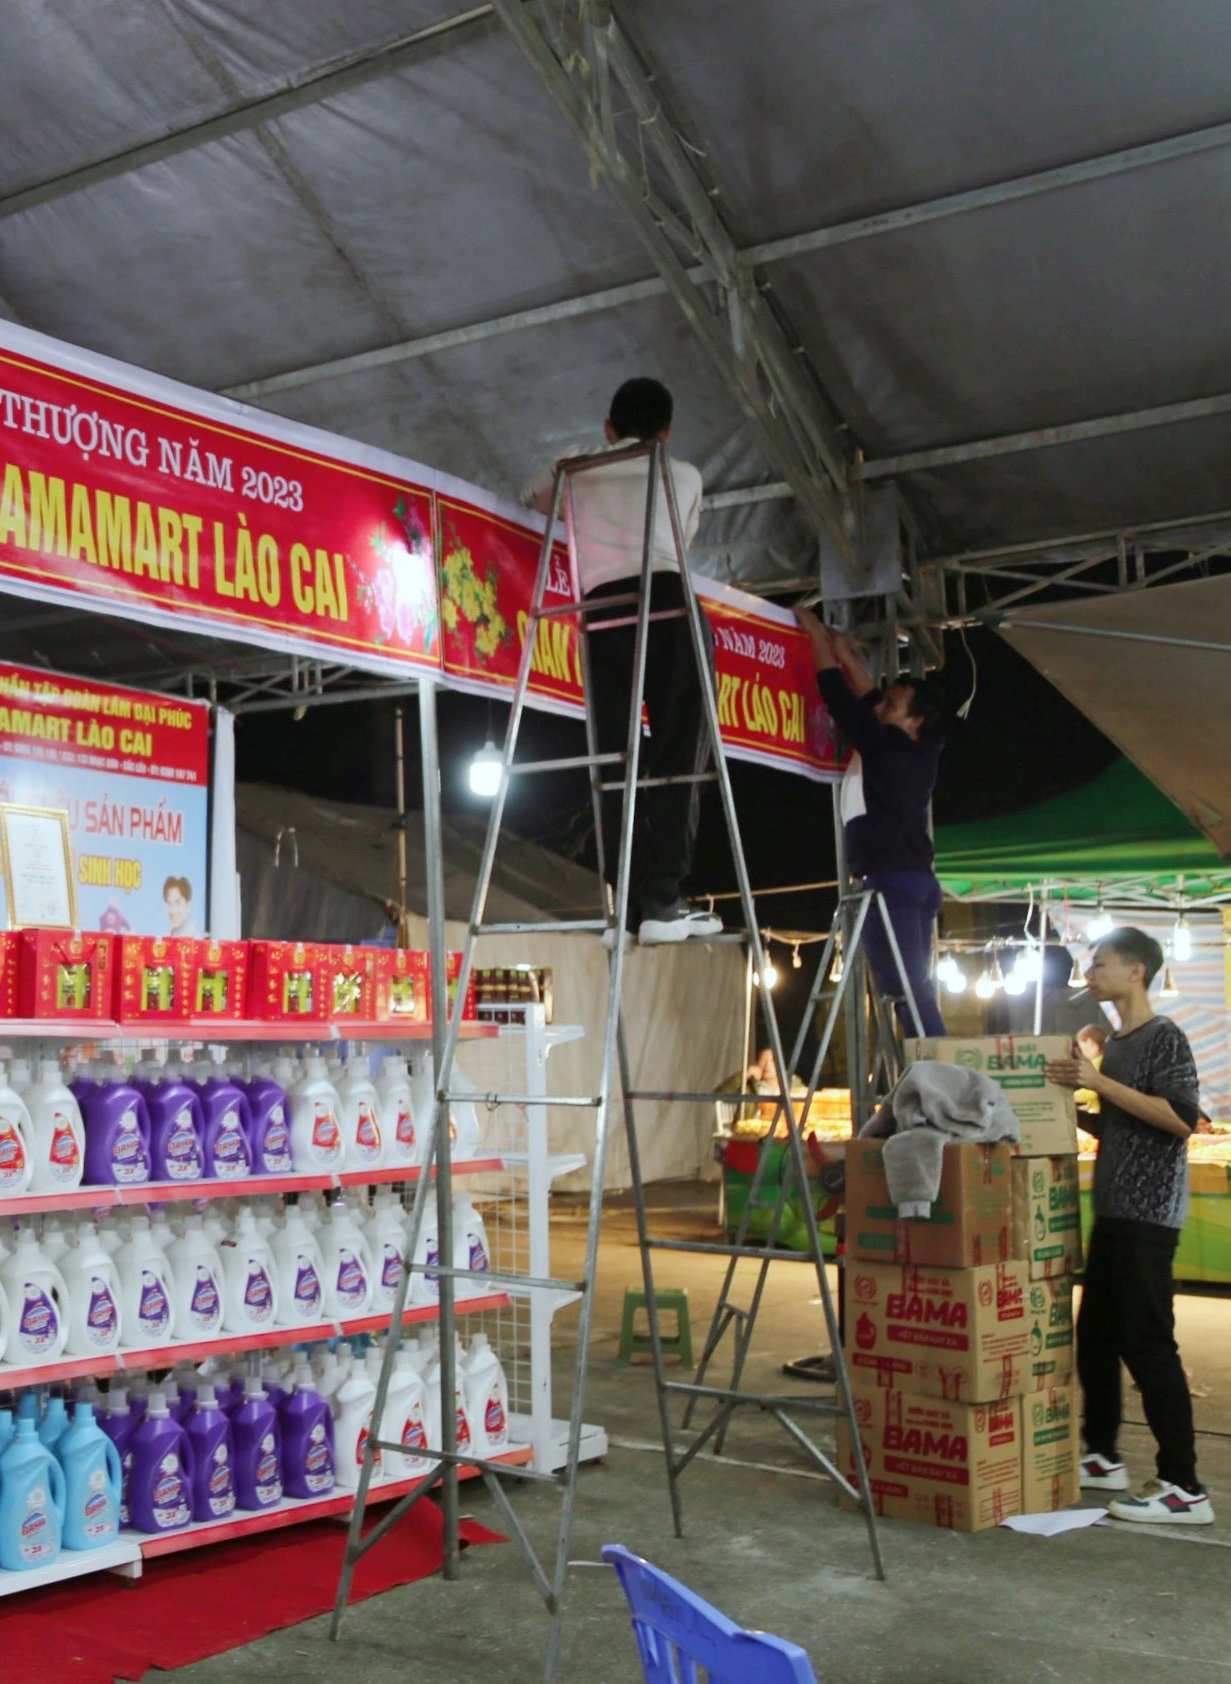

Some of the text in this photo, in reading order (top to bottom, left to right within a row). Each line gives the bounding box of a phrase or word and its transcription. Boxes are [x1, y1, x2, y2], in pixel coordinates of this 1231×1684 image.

[158, 436, 233, 493] NĂM
[242, 467, 304, 512] 2023
[215, 512, 282, 609] LÀO
[290, 543, 349, 622] CAI
[758, 639, 786, 669] 2023
[159, 708, 192, 731] PHÚC
[779, 690, 804, 744] CAI
[76, 719, 114, 751] LÀO
[120, 729, 152, 757] CAI
[85, 793, 124, 837] SẢN
[130, 798, 182, 844] PHẨM
[78, 854, 110, 887] SINH
[114, 858, 141, 894] HỌC
[987, 1054, 1046, 1071] BAMA
[886, 1293, 968, 1328] BAMA
[883, 1425, 968, 1462] BAMA
